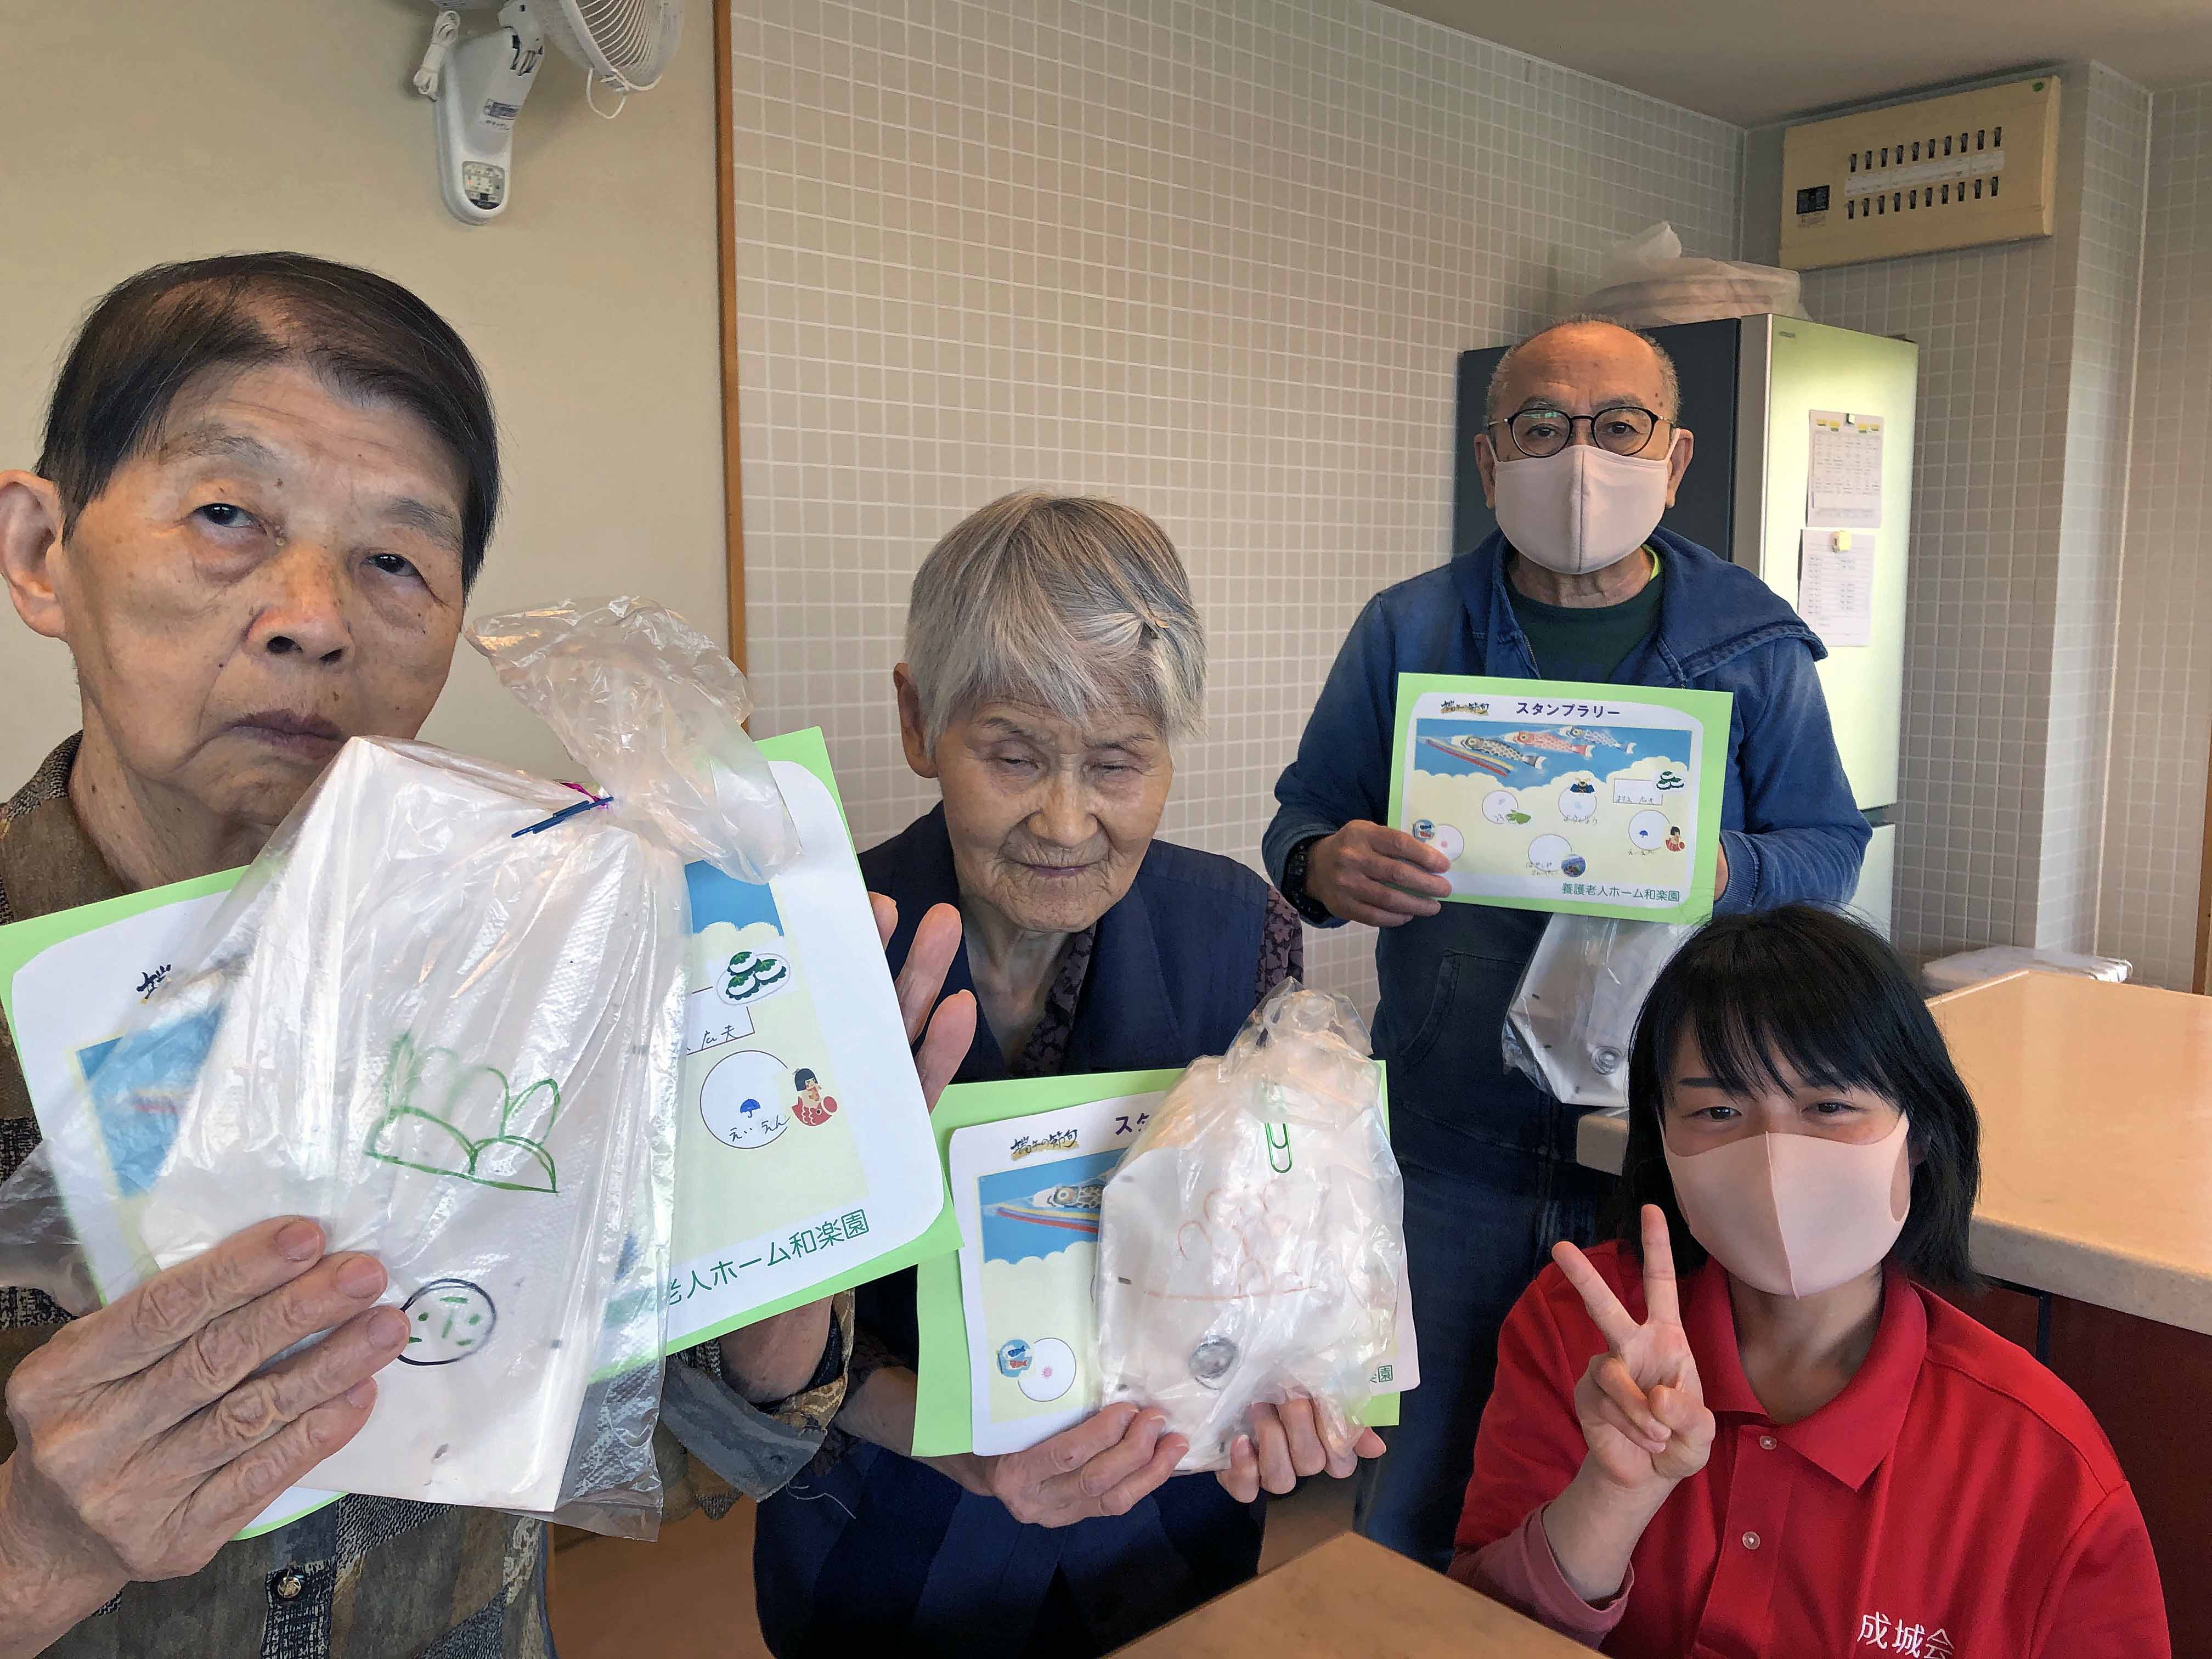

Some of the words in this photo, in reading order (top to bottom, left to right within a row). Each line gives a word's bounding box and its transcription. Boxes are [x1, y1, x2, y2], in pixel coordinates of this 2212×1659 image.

[1516, 702, 1620, 718] スタンプラリー
[1562, 882, 1680, 902] 養護老人ホーム和楽園
[1370, 1364, 1393, 1383] 園
[1857, 1611, 1955, 1659] 成城会
